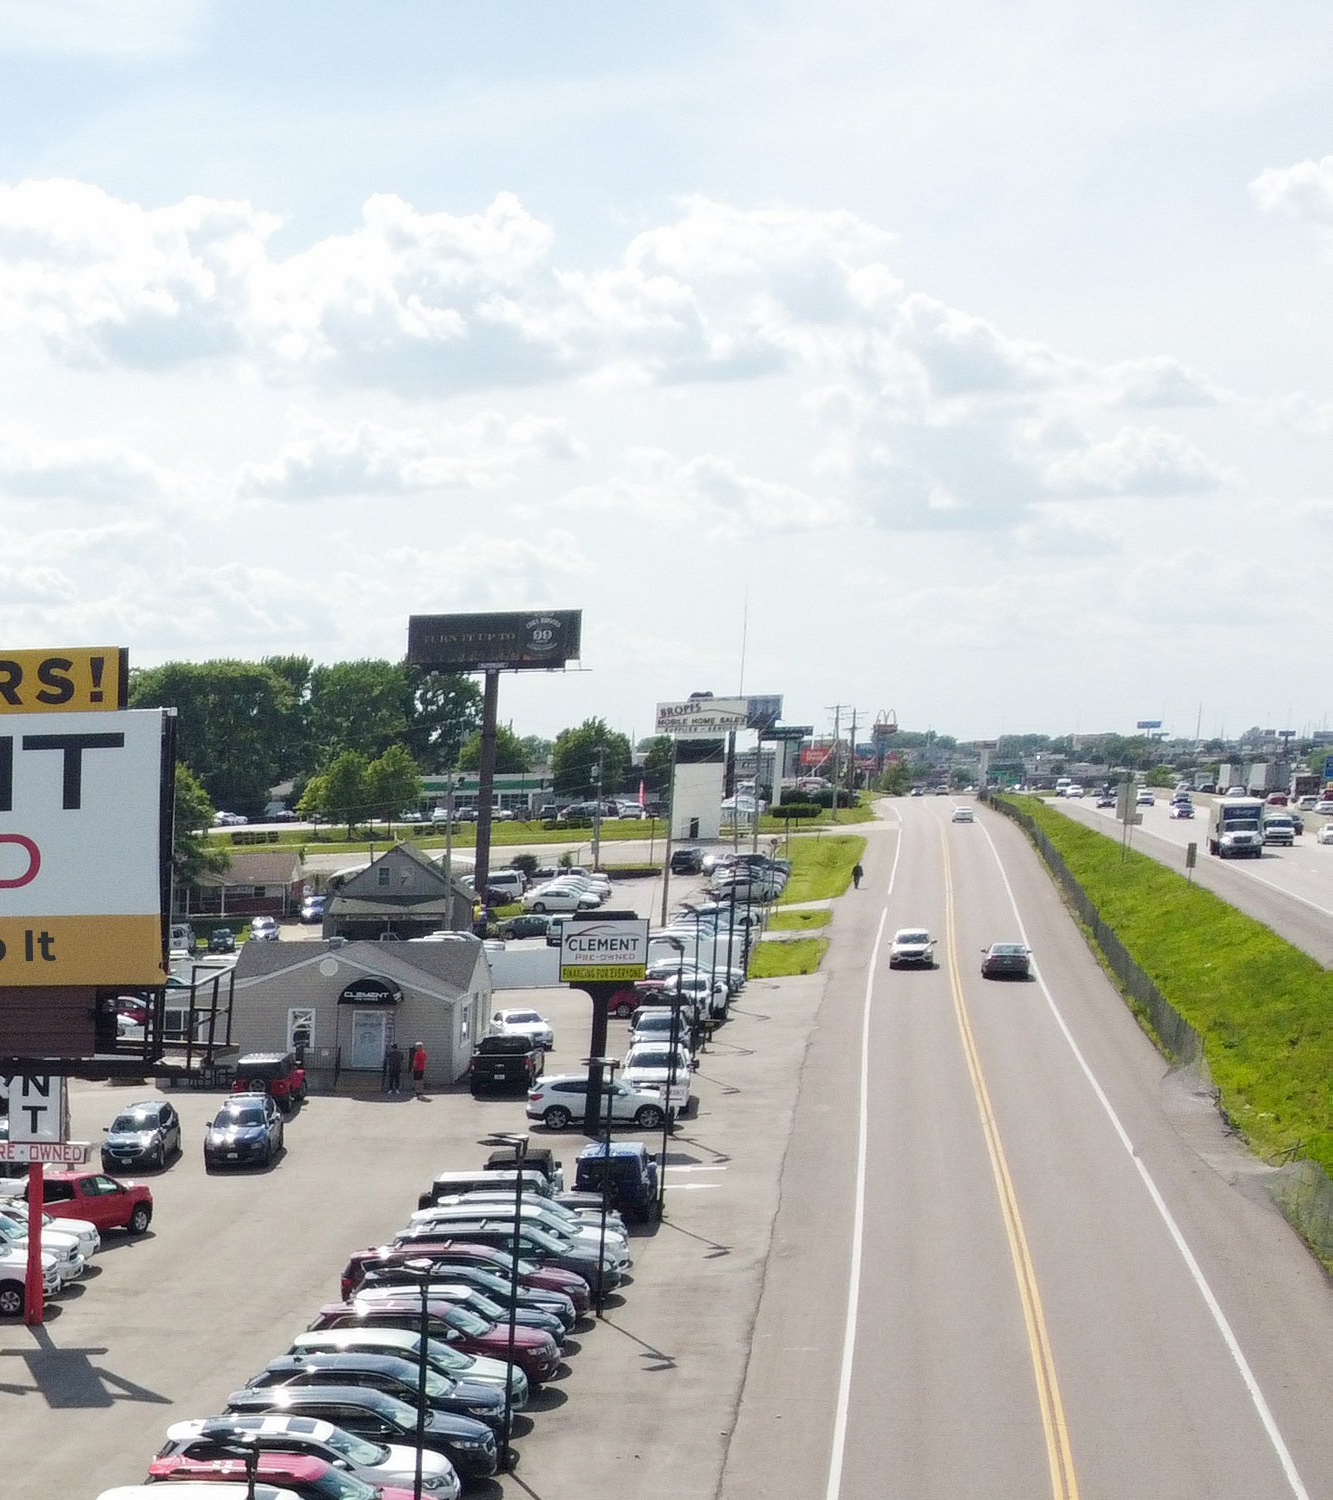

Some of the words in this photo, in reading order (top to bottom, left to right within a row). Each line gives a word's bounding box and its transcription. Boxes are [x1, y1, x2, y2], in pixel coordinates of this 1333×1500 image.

[657, 718, 688, 726] MOBILE
[691, 717, 716, 725] HOME
[25, 929, 57, 963] It
[568, 938, 639, 951] CLEMENT
